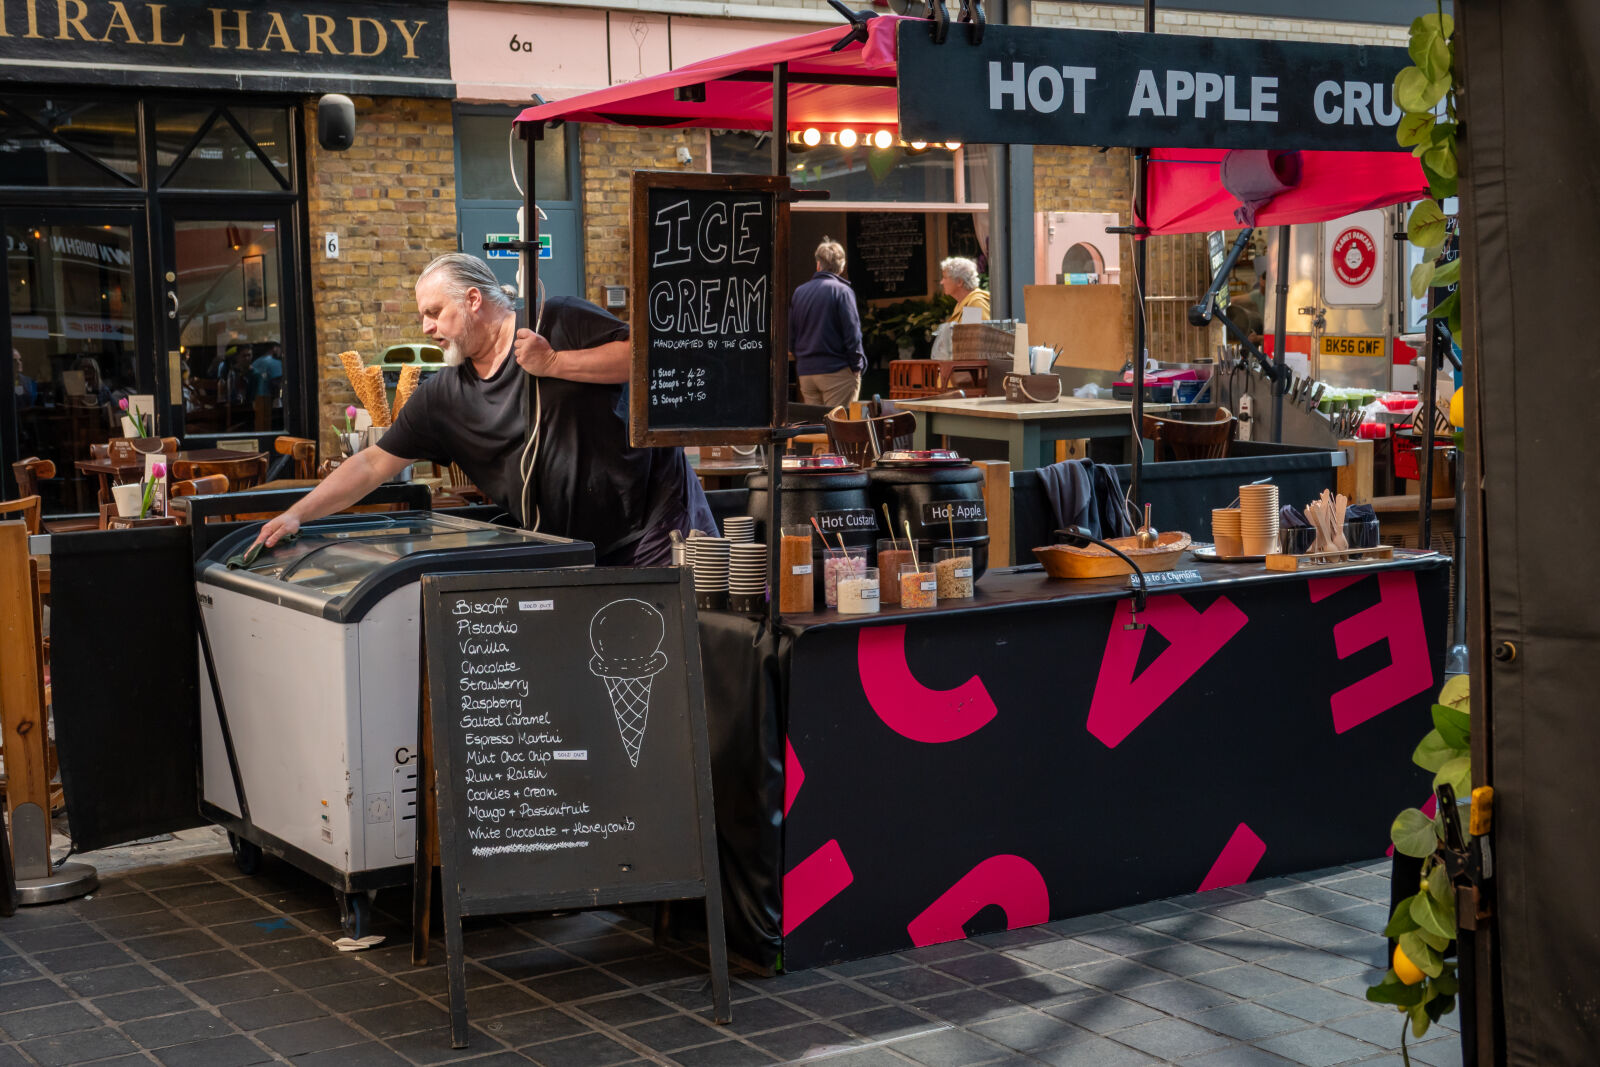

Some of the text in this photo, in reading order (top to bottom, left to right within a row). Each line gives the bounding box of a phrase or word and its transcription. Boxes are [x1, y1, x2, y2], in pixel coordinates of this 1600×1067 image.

[0, 0, 428, 59] IRAL HARDY
[509, 34, 533, 52] 6a
[989, 61, 1097, 114] HOT
[1128, 70, 1278, 123] APPLE
[653, 200, 762, 268] ICE
[328, 239, 336, 252] 6
[649, 275, 766, 335] CREAM
[653, 339, 703, 350] HANDCRAFTED
[707, 339, 718, 349] BY
[722, 340, 736, 348] THE
[1325, 338, 1380, 354] BK56 GWF
[650, 380, 657, 390] 2
[652, 395, 658, 406] 3
[956, 504, 982, 519] Apple
[821, 513, 875, 529] Hot Custard
[1152, 574, 1160, 582] to
[452, 597, 509, 614] Biscoff
[456, 619, 518, 636] Pistachio
[459, 638, 510, 655] Vanilla
[461, 660, 521, 675] Chocolate
[459, 677, 529, 698] Strawberry
[461, 695, 522, 716] Raspberry
[459, 711, 551, 729] Salted Caramel
[465, 729, 563, 750] Espresso Martini
[466, 750, 552, 766] Mint Choc Chip
[465, 768, 493, 785] Rum
[506, 766, 547, 782] Raisin
[466, 788, 511, 801] Cookies
[523, 787, 557, 798] Cream
[468, 806, 506, 822] Mango
[519, 802, 590, 818] Passionfruit
[468, 826, 500, 840] White
[505, 827, 558, 839] Chocolate
[572, 816, 636, 839] Honeycomb
